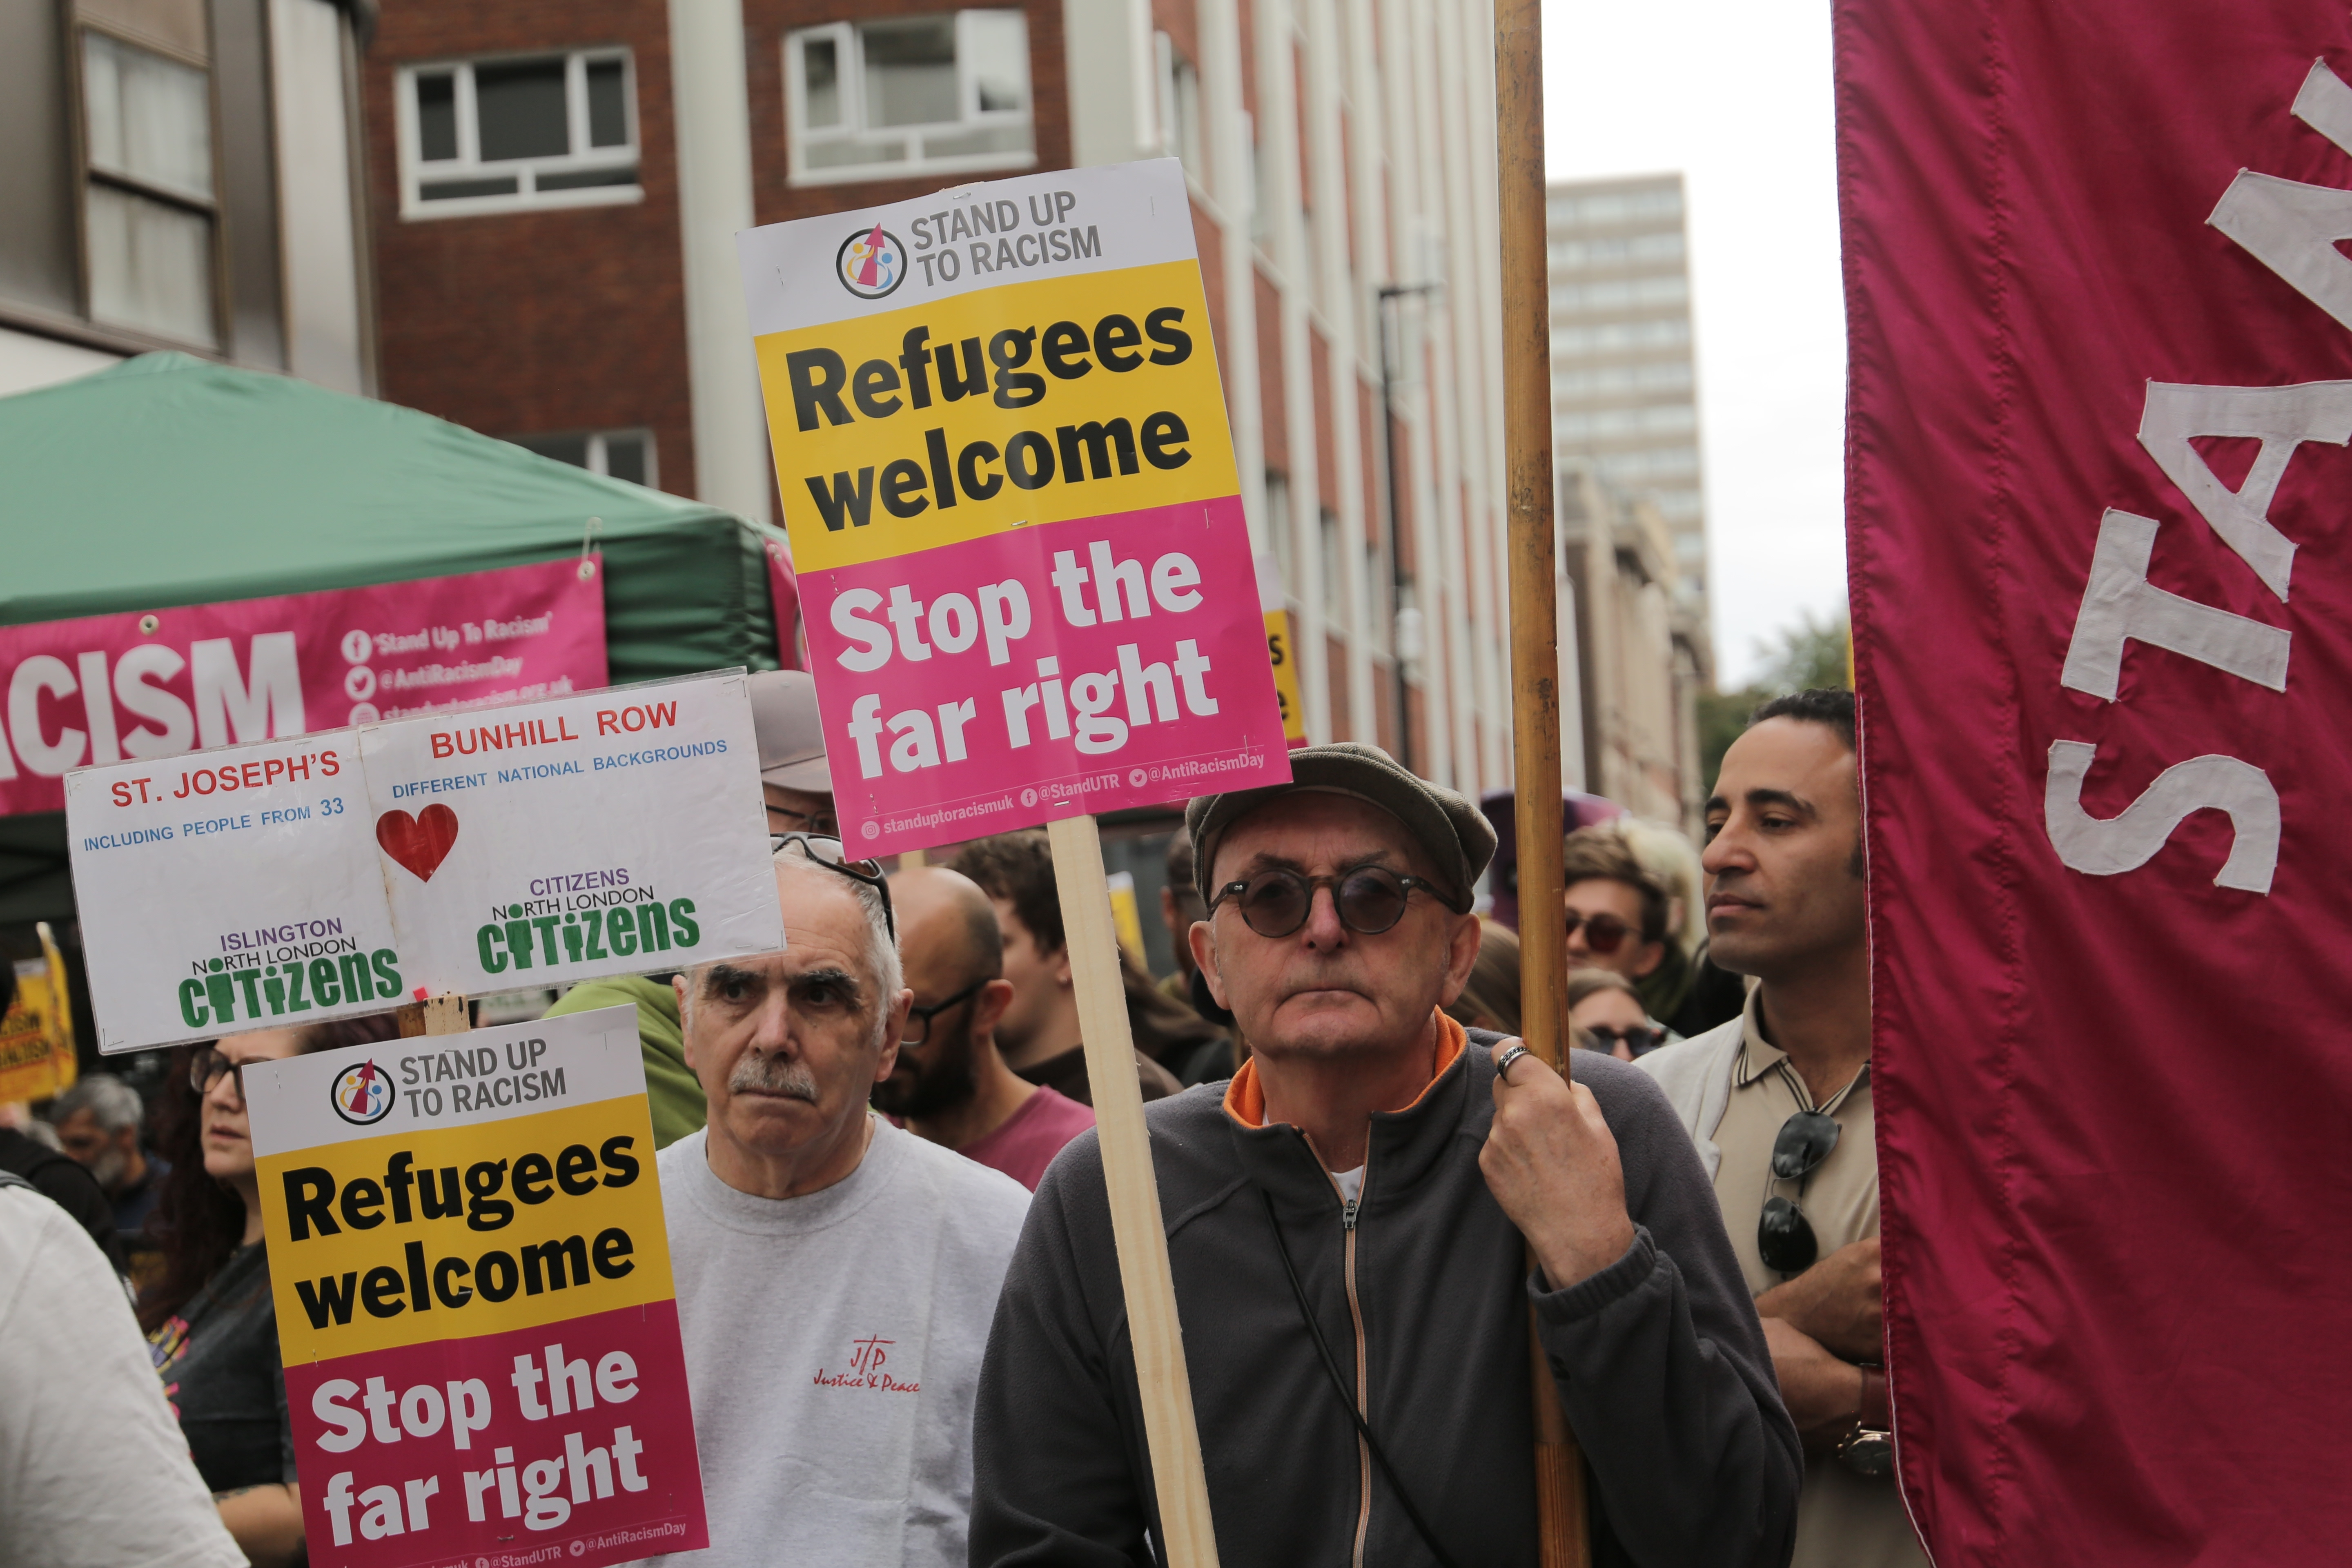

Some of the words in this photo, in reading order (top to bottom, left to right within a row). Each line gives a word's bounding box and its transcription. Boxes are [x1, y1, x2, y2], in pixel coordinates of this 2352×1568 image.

[911, 199, 1020, 250] STAND
[1029, 191, 1076, 226] UP
[916, 249, 961, 287] TO
[972, 225, 1102, 275] RACISM
[786, 306, 1192, 432] Refugees
[805, 411, 1192, 532] welcome
[830, 578, 1031, 672] Stop
[1051, 540, 1203, 627] the
[432, 626, 460, 651] Up
[461, 621, 483, 644] To
[0, 630, 305, 780] CISM
[430, 716, 578, 759] BUNHILL
[597, 701, 677, 736] ROW
[848, 694, 976, 779] far
[1001, 638, 1219, 755] right
[111, 778, 162, 807] ST.
[173, 751, 340, 799] JOSEPH'S
[392, 773, 487, 799] DIFFERENT
[498, 761, 584, 783] NATIONAL
[593, 739, 727, 770] BACKGROUNDS
[883, 795, 1013, 834] standuptoracismuk
[1038, 774, 1120, 800] @StandUTR
[1148, 753, 1265, 782] @AntiRacismDay
[84, 827, 174, 851] INCLUDING
[183, 815, 252, 837] PEOPLE
[261, 805, 311, 825] FROM
[320, 797, 344, 816] 33
[492, 897, 560, 921] NORTH
[566, 885, 654, 911] LONDON
[530, 868, 629, 896] CITIZENS
[192, 951, 261, 975] NORTH
[267, 936, 356, 964] LONDON
[220, 917, 343, 951] ISLINGTON
[400, 1048, 498, 1084] STAND
[506, 1038, 547, 1070] UP
[404, 1087, 443, 1118] TO
[454, 1067, 567, 1113] RACISM
[282, 1136, 640, 1242] Refugees
[294, 1227, 635, 1330] welcome
[312, 1376, 491, 1453] Stop
[511, 1343, 639, 1421] the
[814, 1368, 864, 1387] Justice
[867, 1373, 878, 1388] &
[882, 1373, 920, 1392] Peace
[323, 1471, 439, 1547] far
[463, 1425, 648, 1531] right
[490, 1546, 562, 1568] @StandUTR
[586, 1522, 686, 1550] @AntiRacismDay
